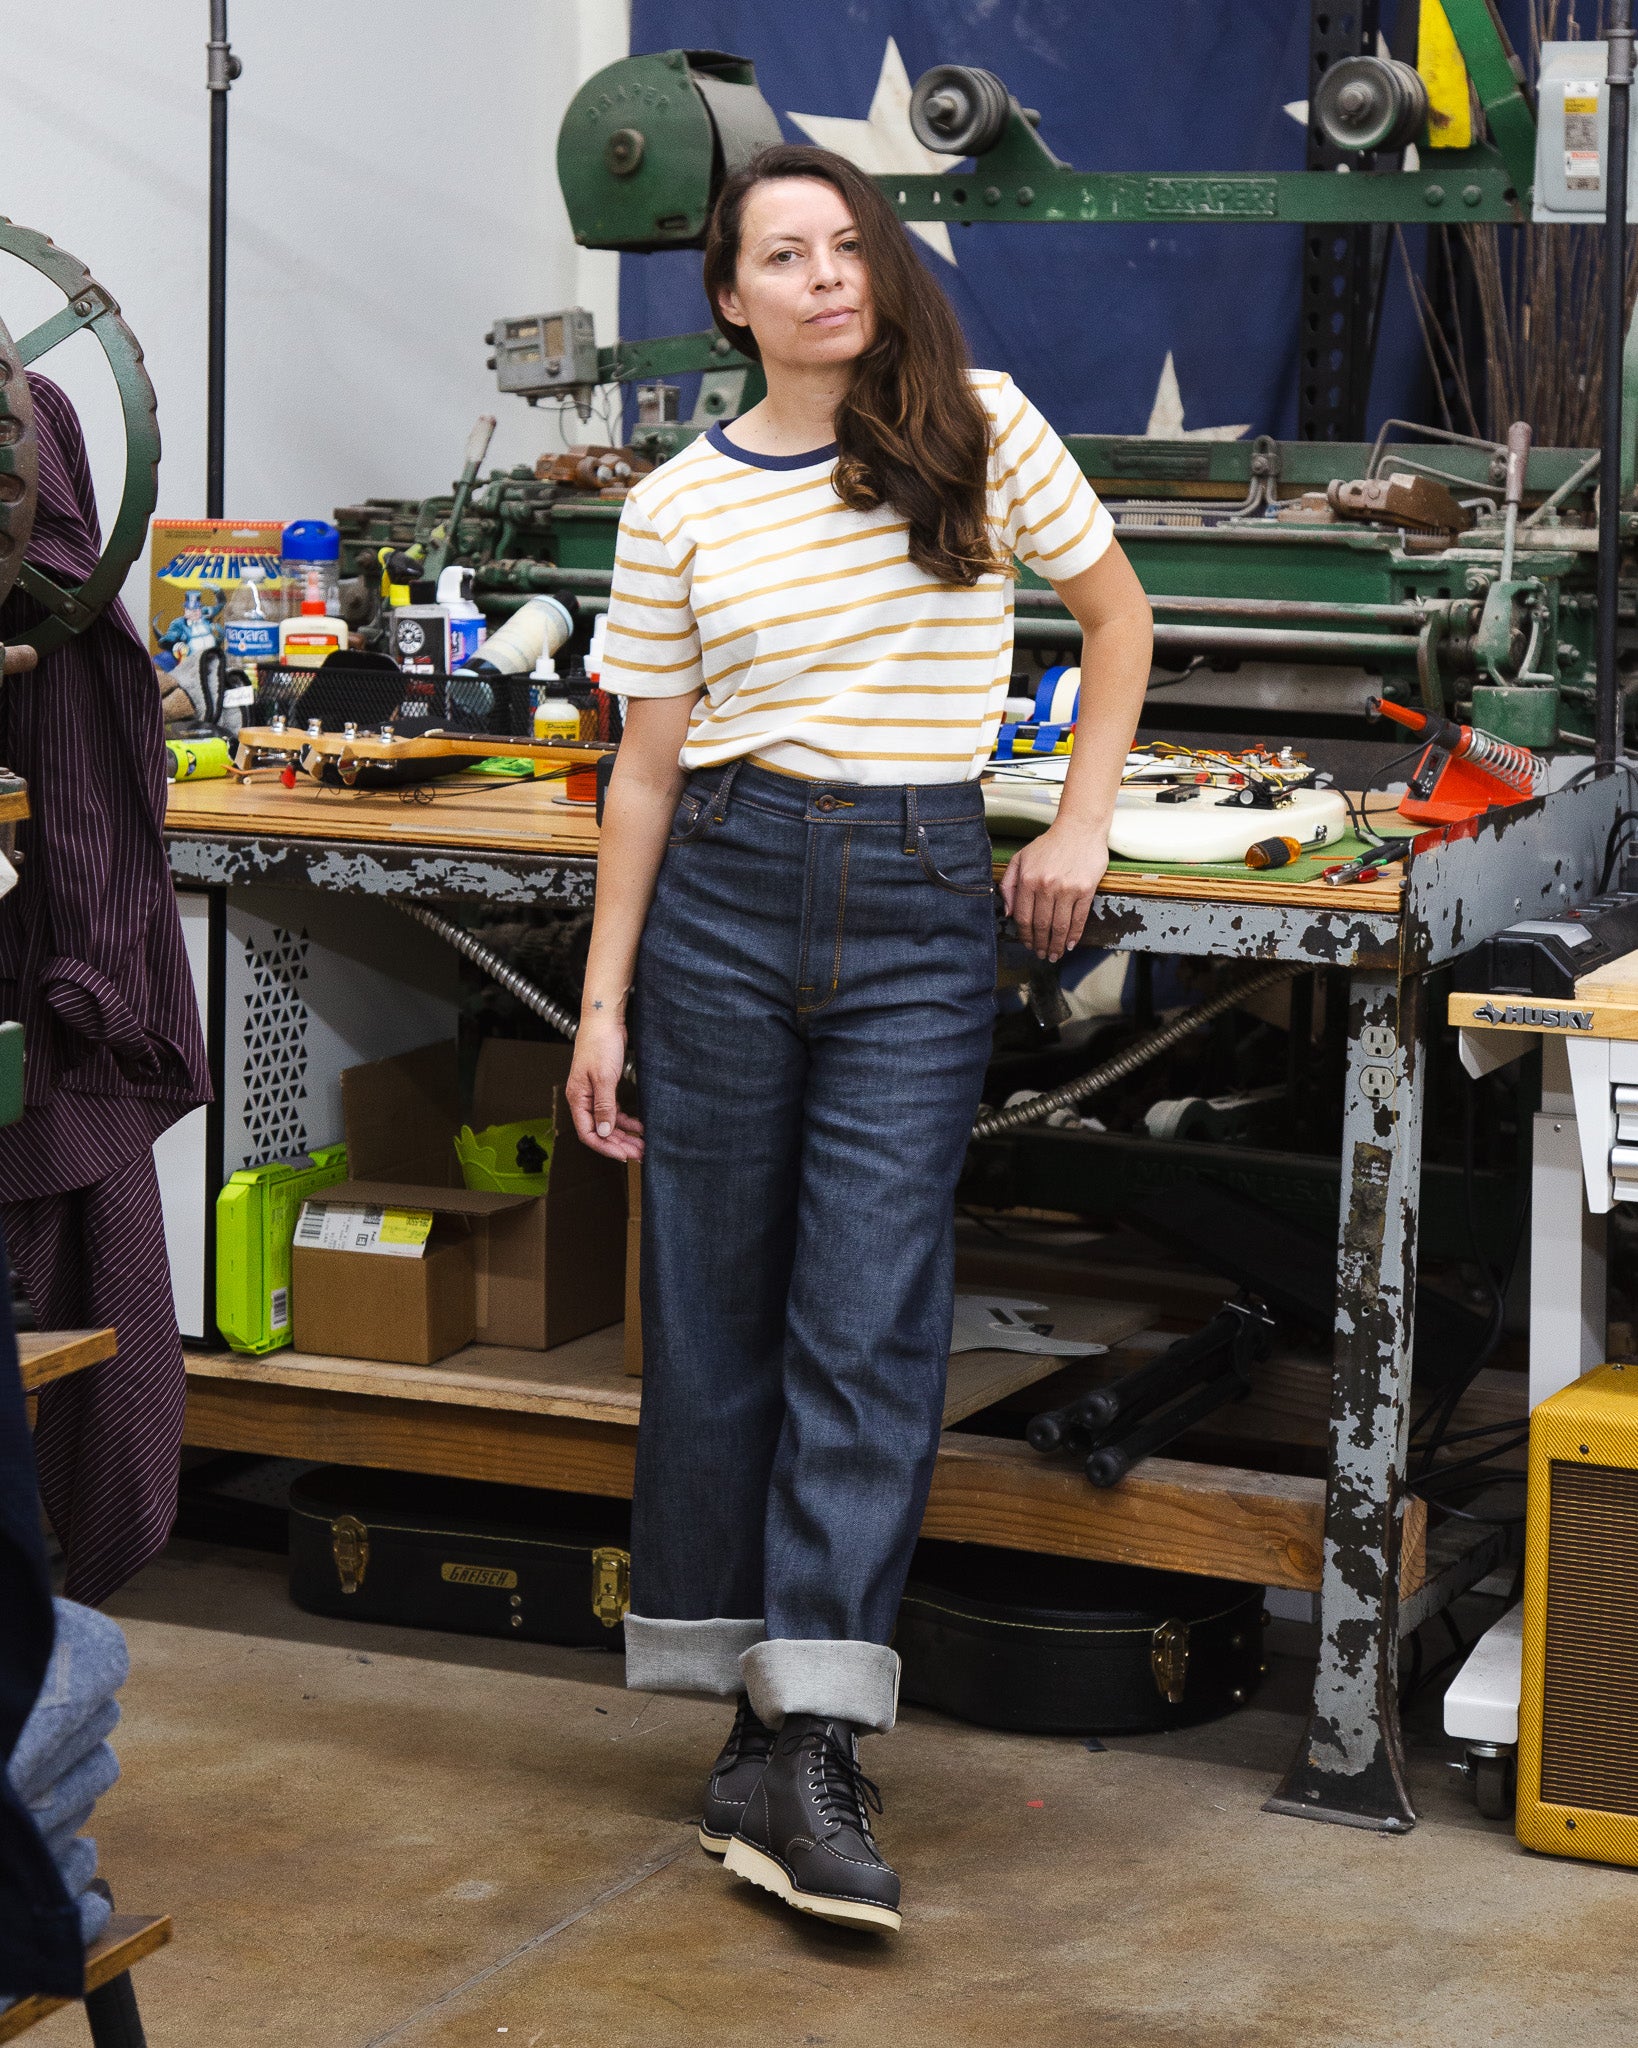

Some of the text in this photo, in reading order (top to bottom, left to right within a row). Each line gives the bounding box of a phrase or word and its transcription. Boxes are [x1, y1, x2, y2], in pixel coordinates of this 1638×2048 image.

[1155, 181, 1268, 213] DRAPER
[157, 553, 225, 579] SUPER
[1505, 1005, 1593, 1030] HUSKY
[449, 1565, 509, 1586] GRETSCH
